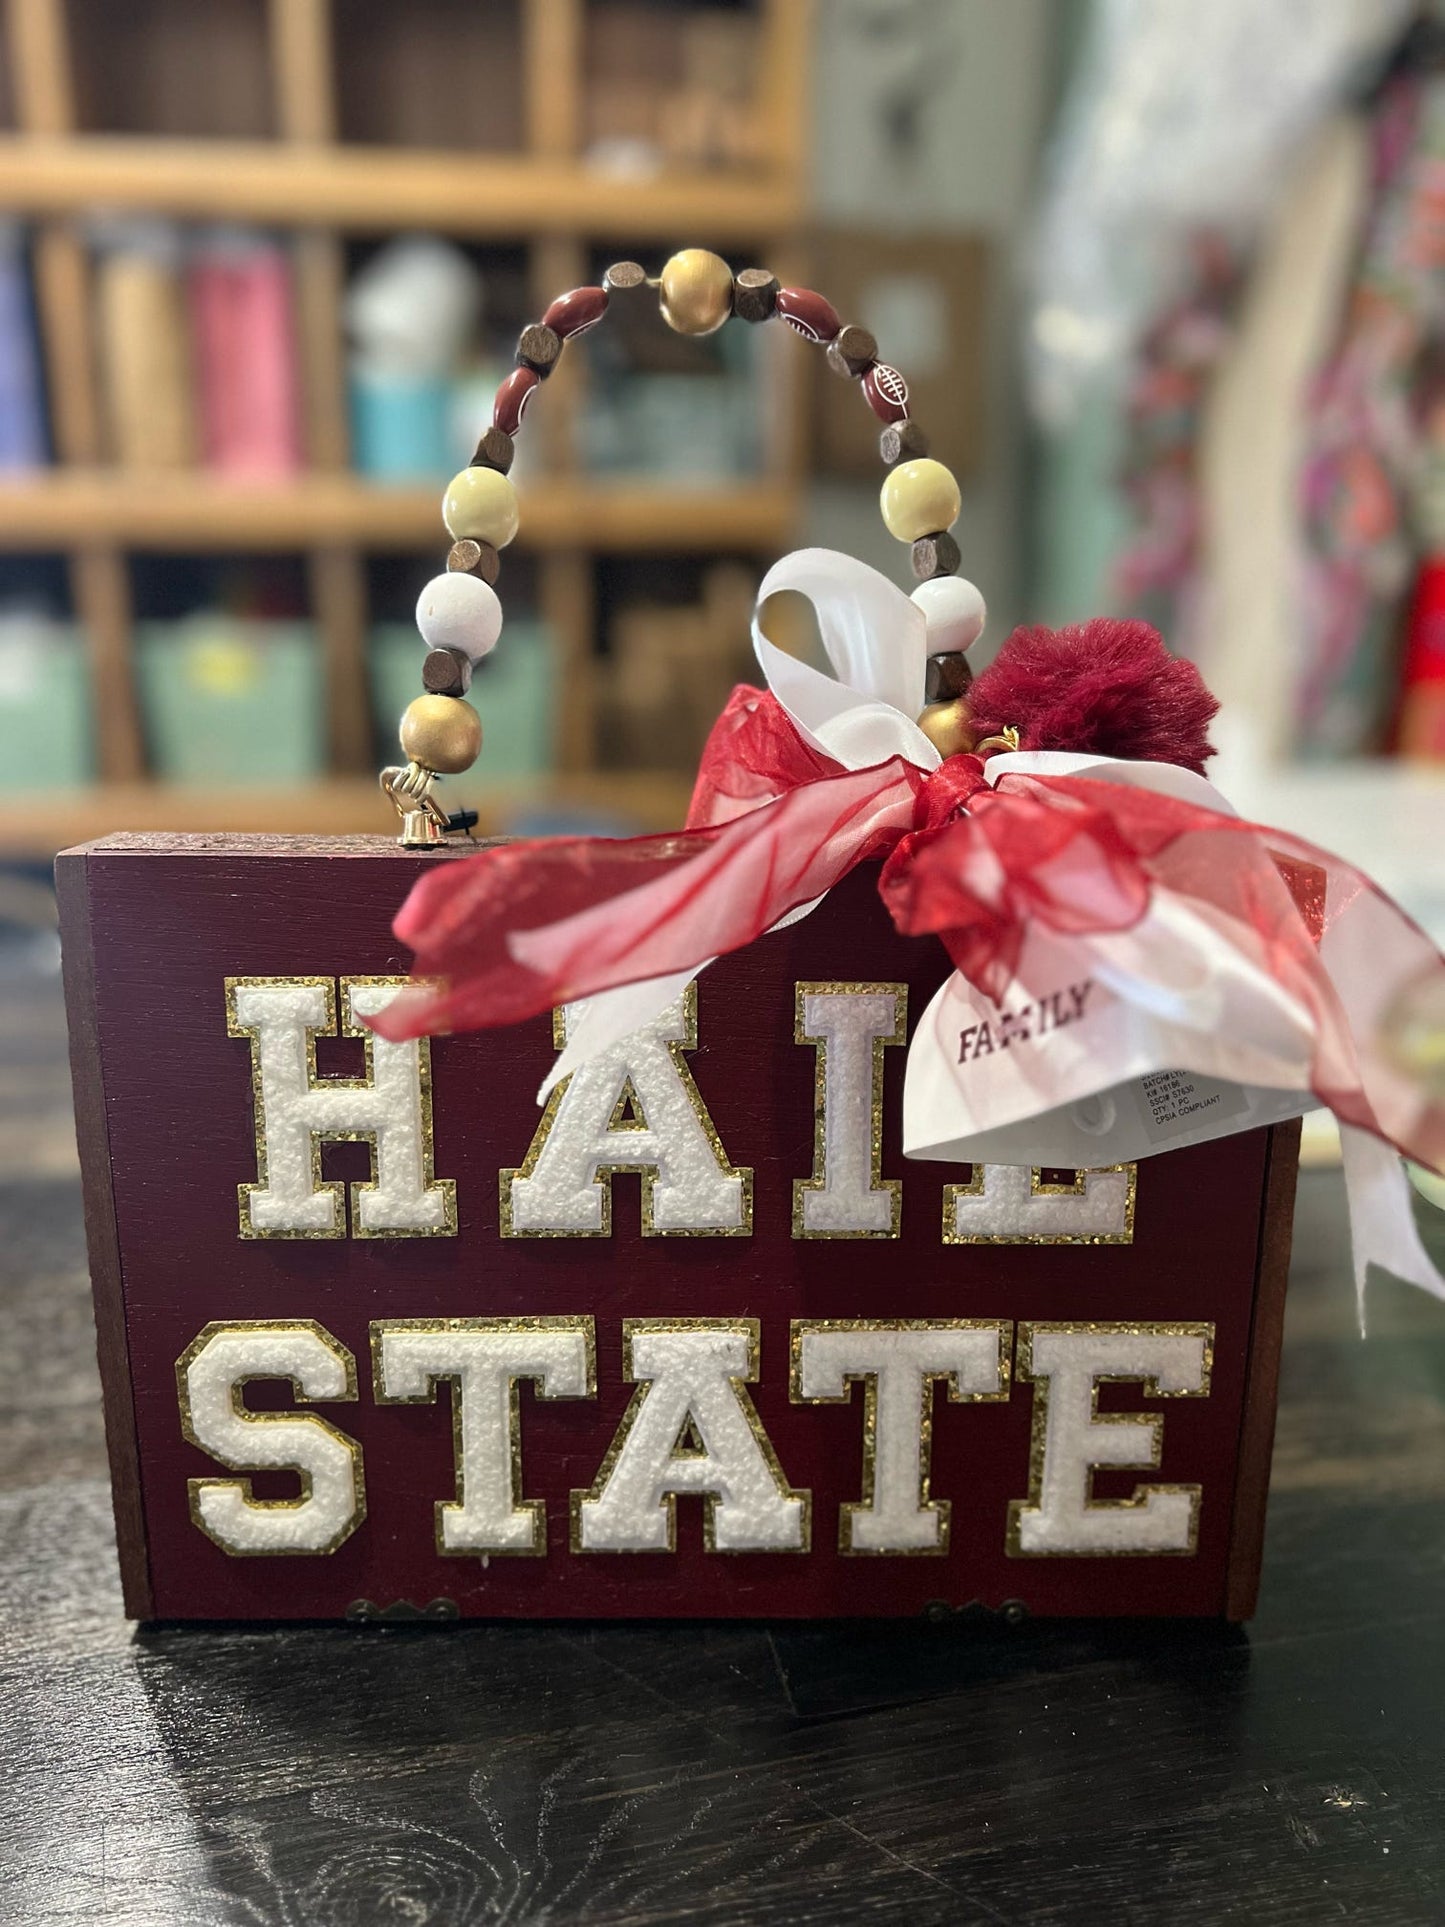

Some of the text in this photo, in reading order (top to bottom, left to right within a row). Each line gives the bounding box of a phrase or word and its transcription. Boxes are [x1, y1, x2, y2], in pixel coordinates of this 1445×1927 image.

[1155, 1094, 1220, 1125] CPSIA COMPLIANT
[1178, 1097, 1189, 1106] PC
[175, 1314, 1216, 1558] STATE
